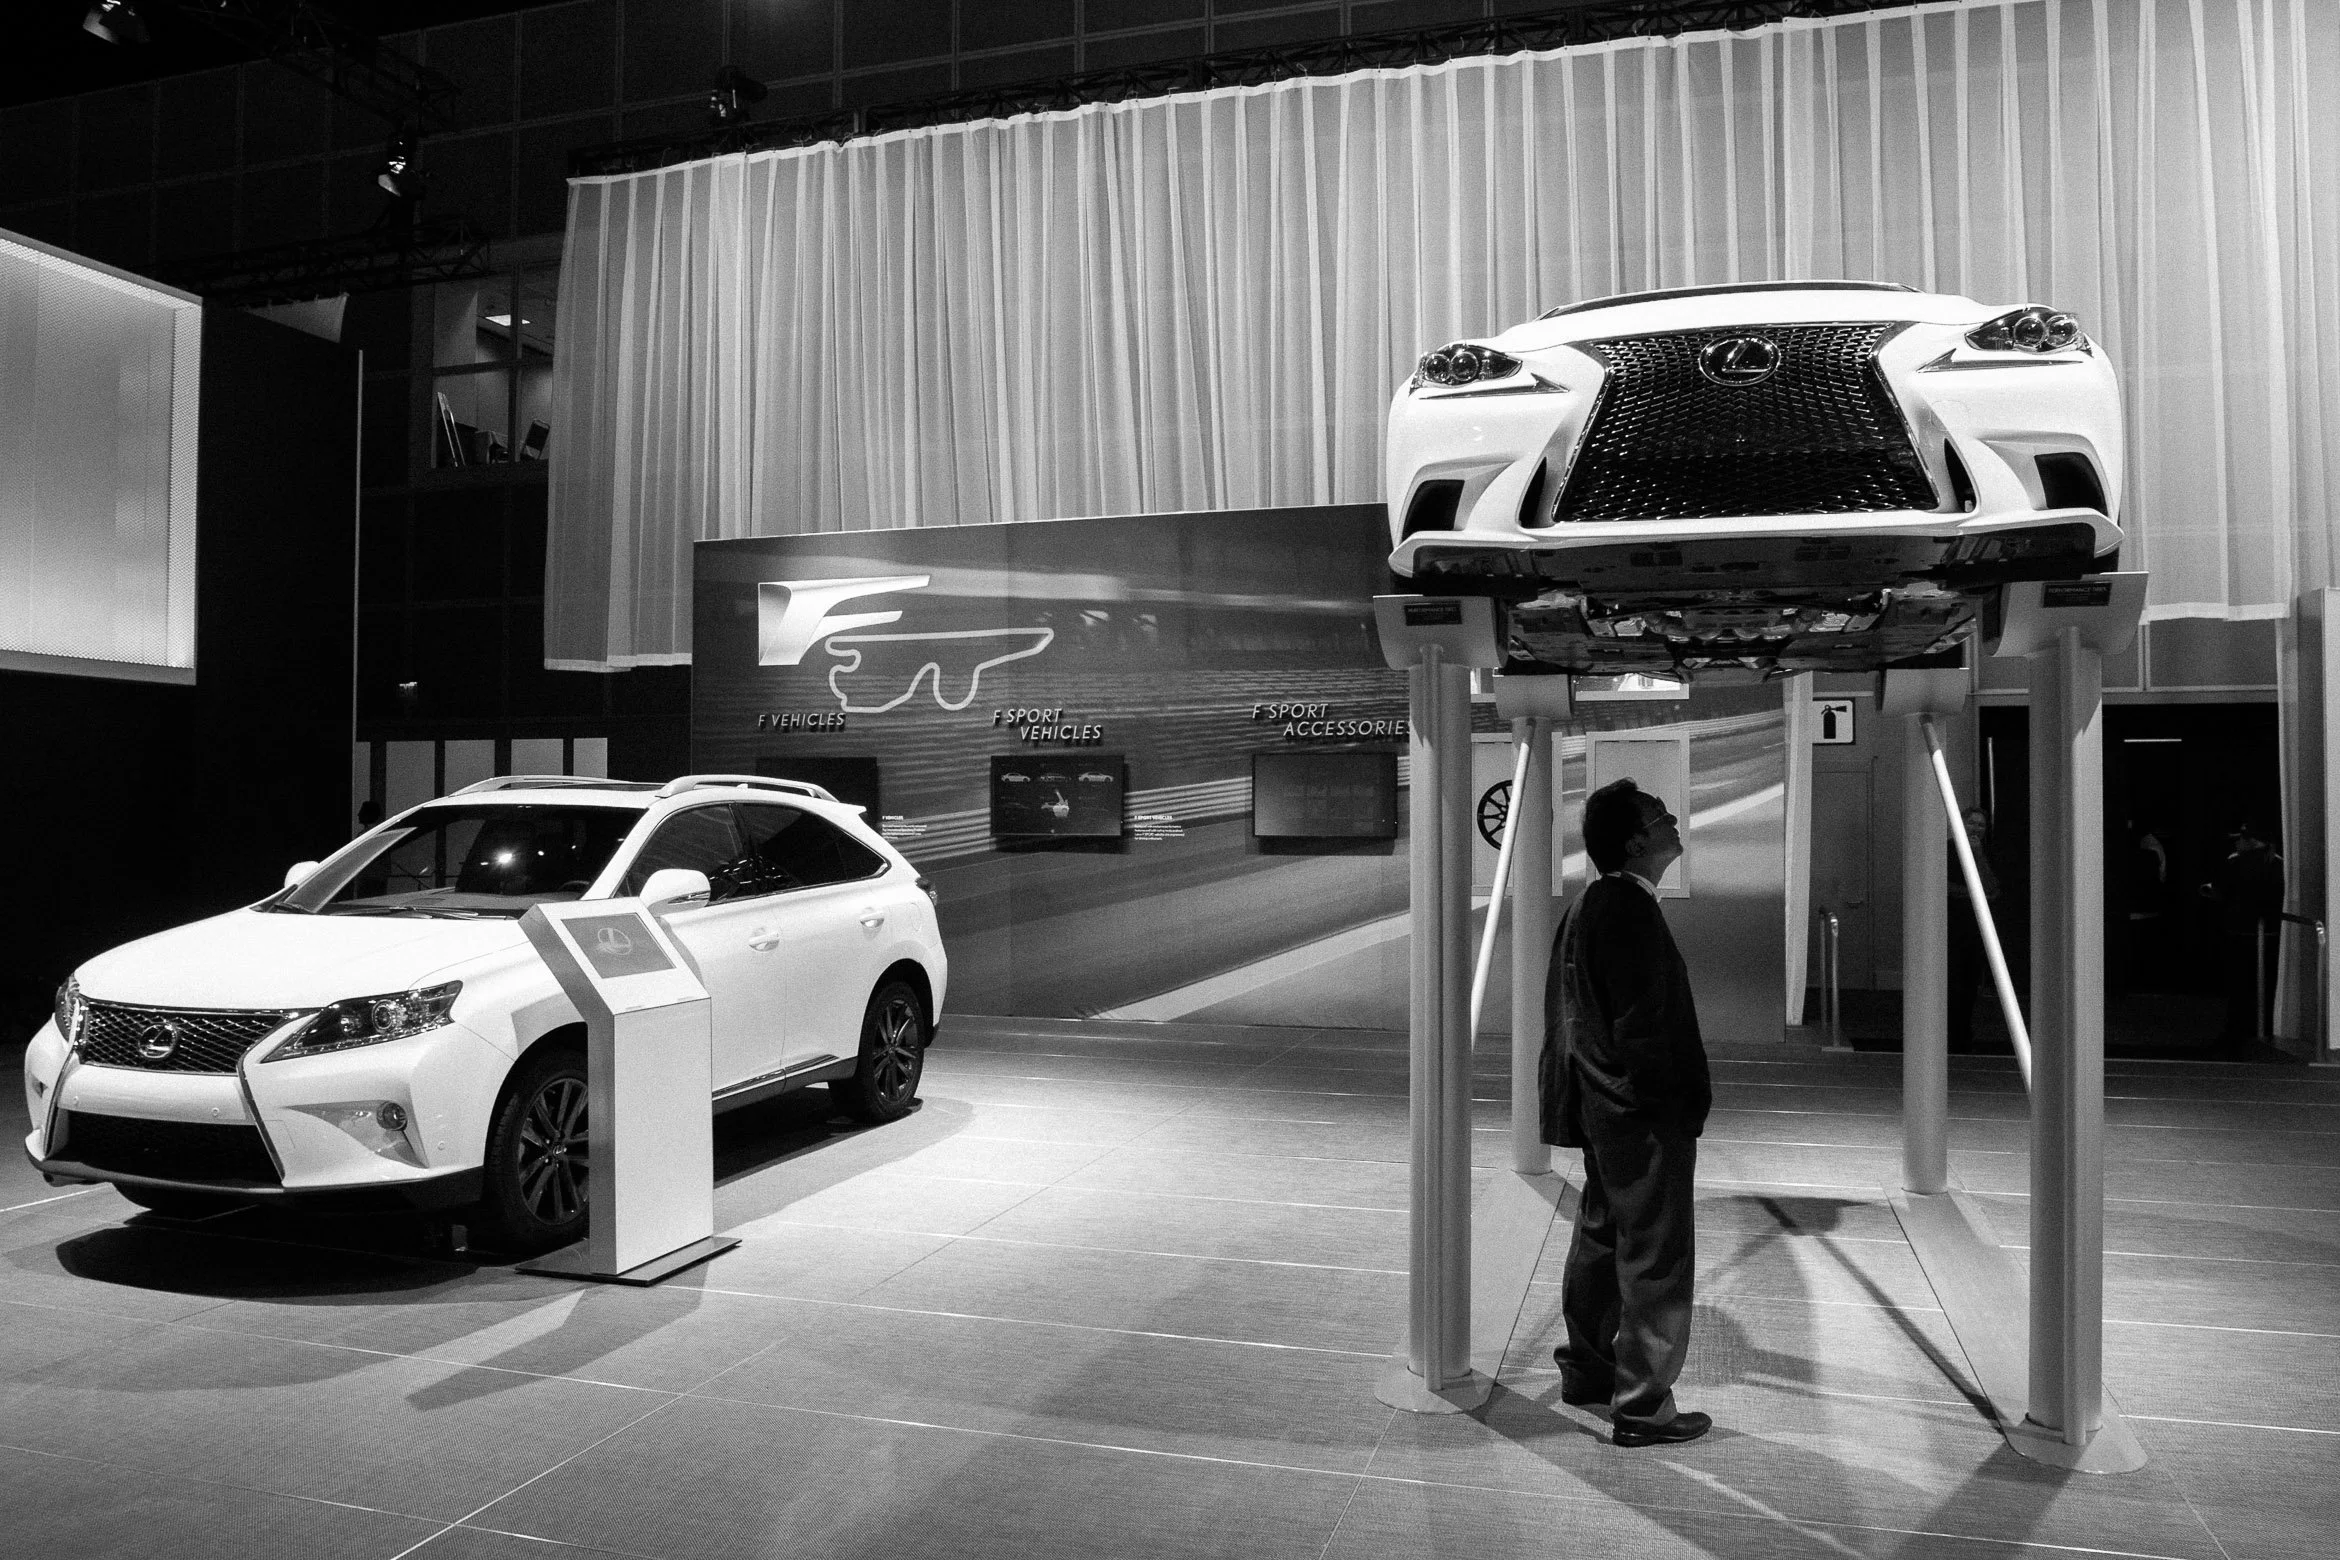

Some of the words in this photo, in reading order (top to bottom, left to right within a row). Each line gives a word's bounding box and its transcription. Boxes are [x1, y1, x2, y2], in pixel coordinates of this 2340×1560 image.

[993, 709, 1001, 723] F
[1006, 708, 1063, 723] SPORT
[1252, 704, 1261, 719] F
[1269, 703, 1329, 719] SPORT
[758, 714, 766, 727] F
[771, 712, 847, 727] VEHICLES
[1020, 725, 1102, 740] VEHICLES
